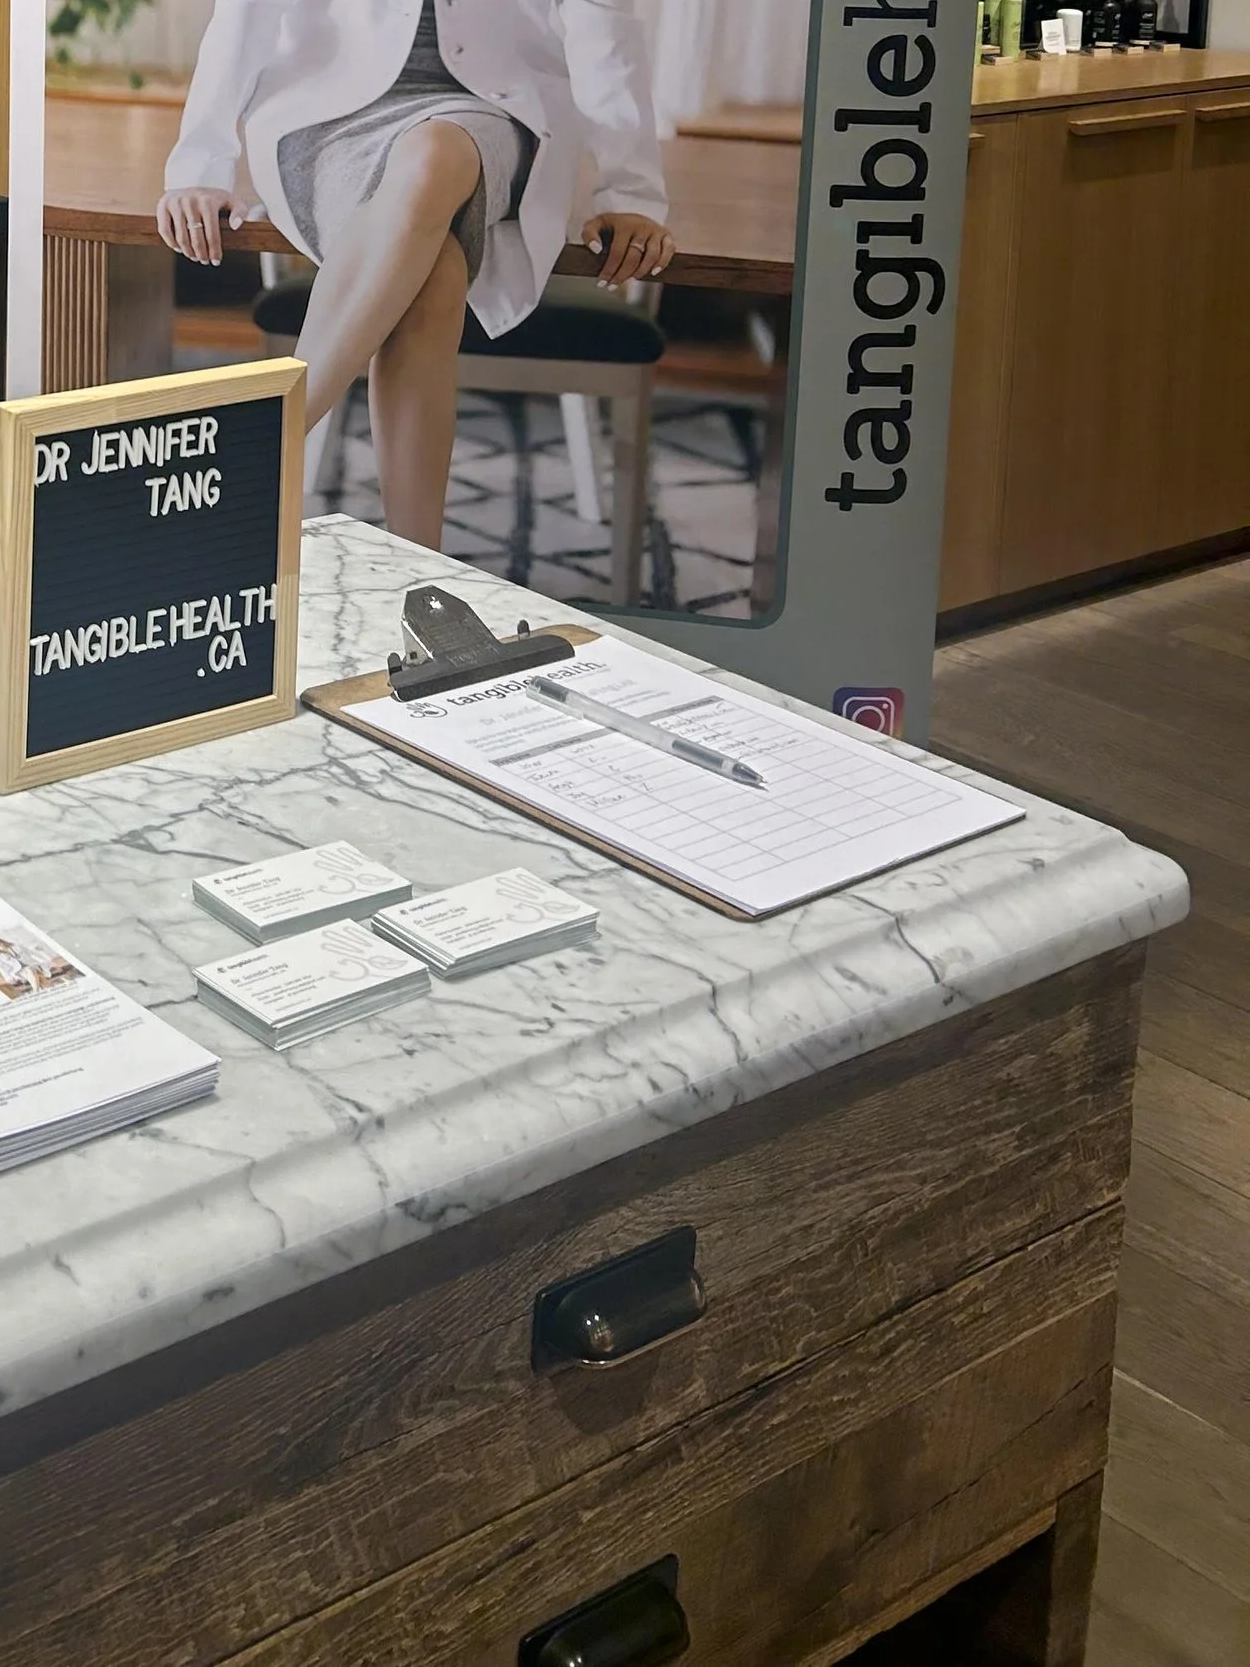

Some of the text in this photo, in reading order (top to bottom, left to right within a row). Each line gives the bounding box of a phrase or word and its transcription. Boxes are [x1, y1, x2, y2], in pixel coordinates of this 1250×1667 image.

[34, 415, 219, 487] DR JENNIFER
[145, 468, 222, 518] TANG
[30, 583, 278, 677] TANGIBLEHEALTH
[196, 631, 247, 678] .CA
